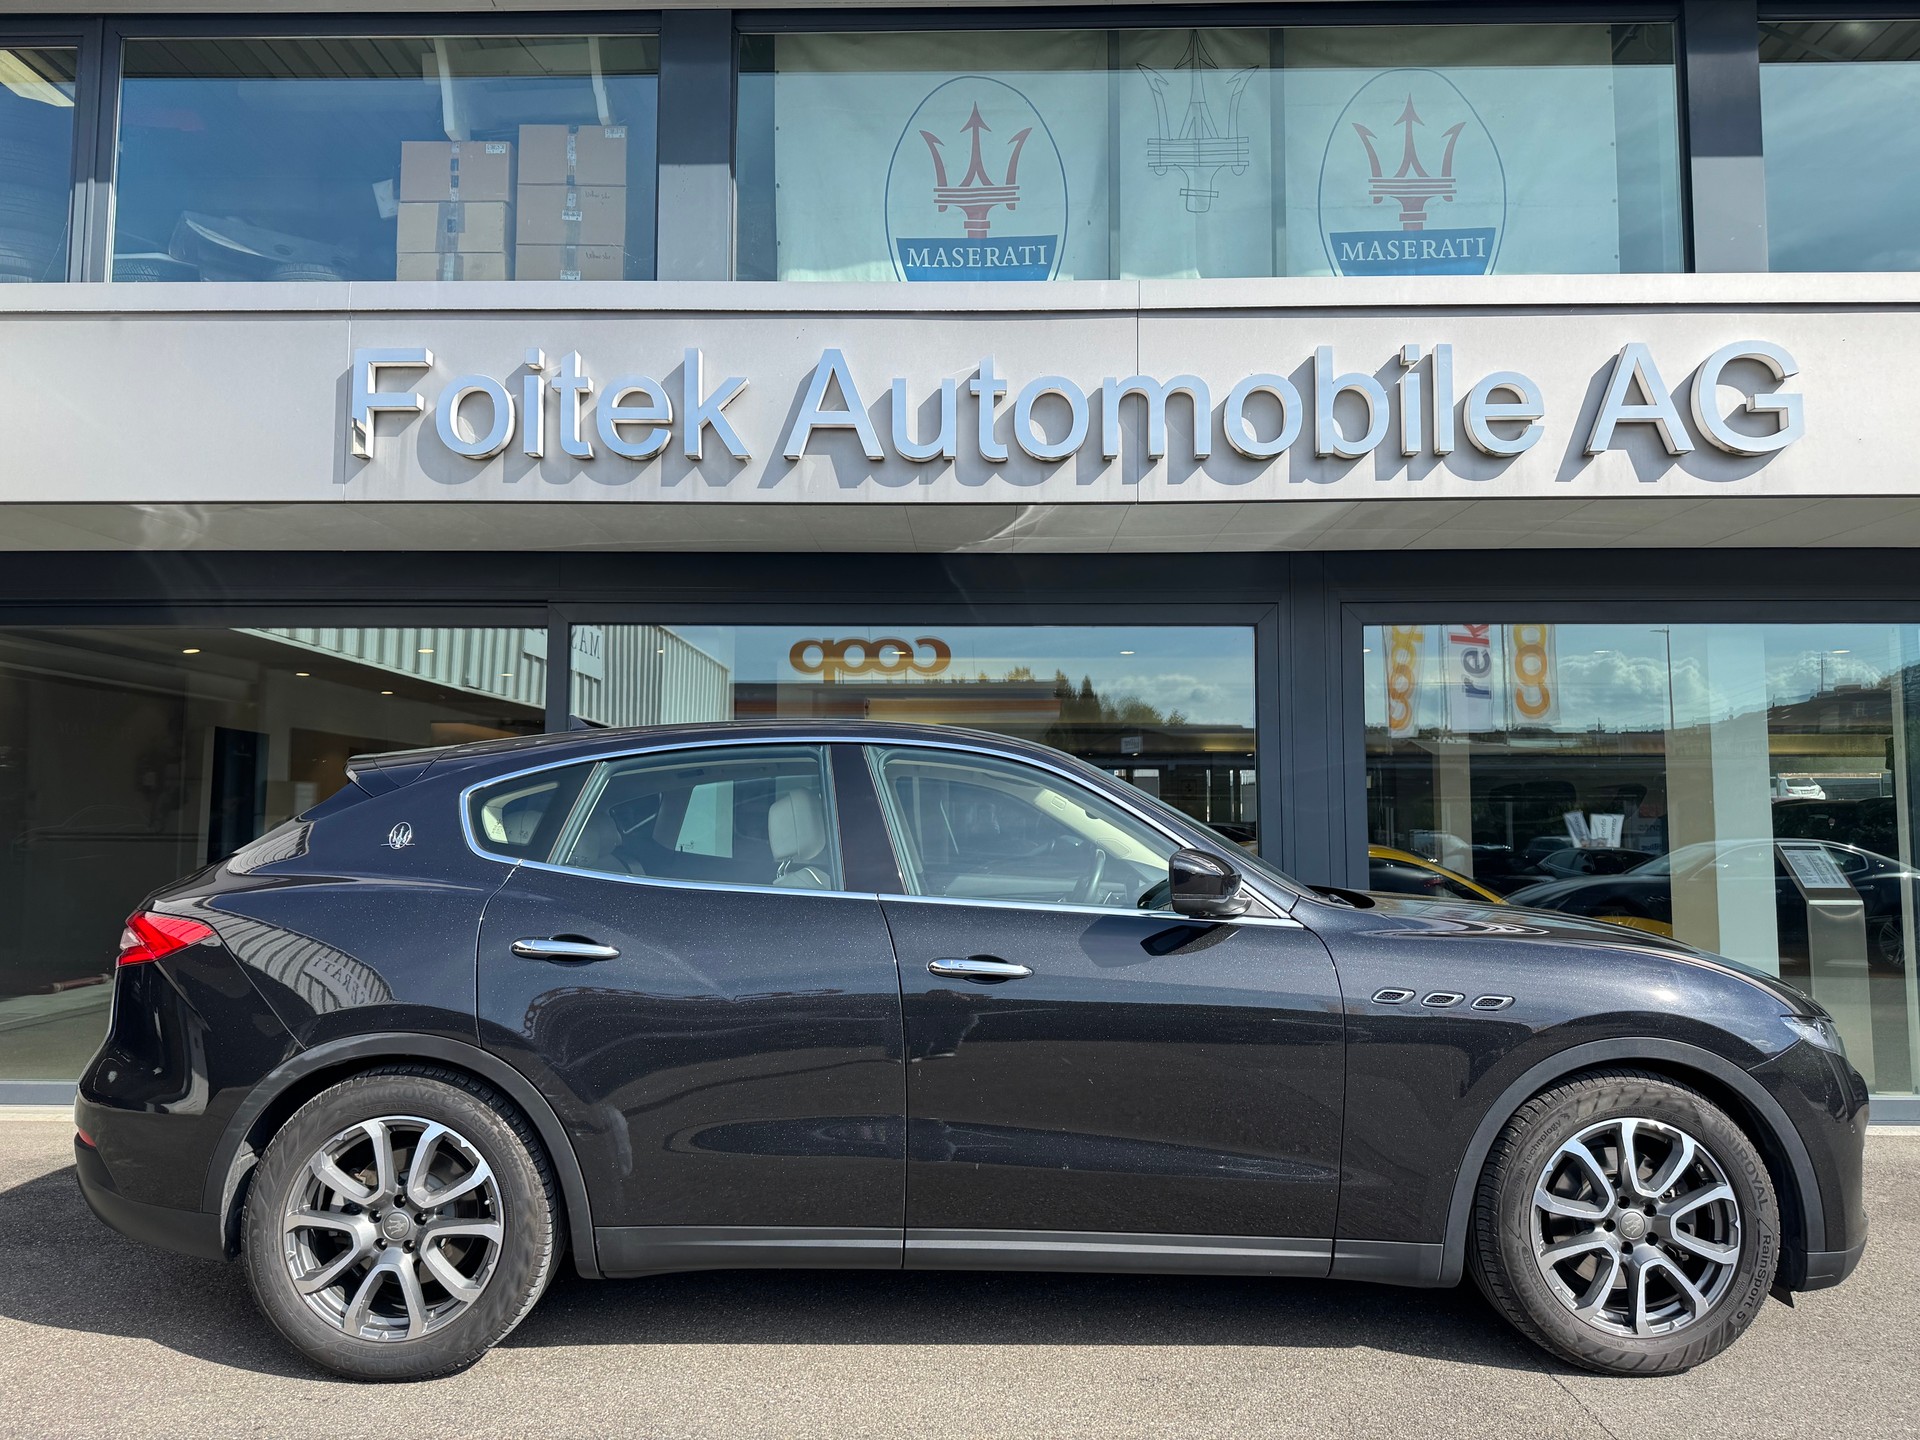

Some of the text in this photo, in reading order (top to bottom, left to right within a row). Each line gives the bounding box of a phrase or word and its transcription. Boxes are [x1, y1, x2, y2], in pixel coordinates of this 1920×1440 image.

[905, 243, 1048, 270] MASERATI
[1340, 234, 1487, 263] MASERATI
[350, 339, 1806, 463] Foitek Automobile AG
[1522, 1119, 1562, 1165] Technology
[1736, 1234, 1773, 1321] RainSport 5
